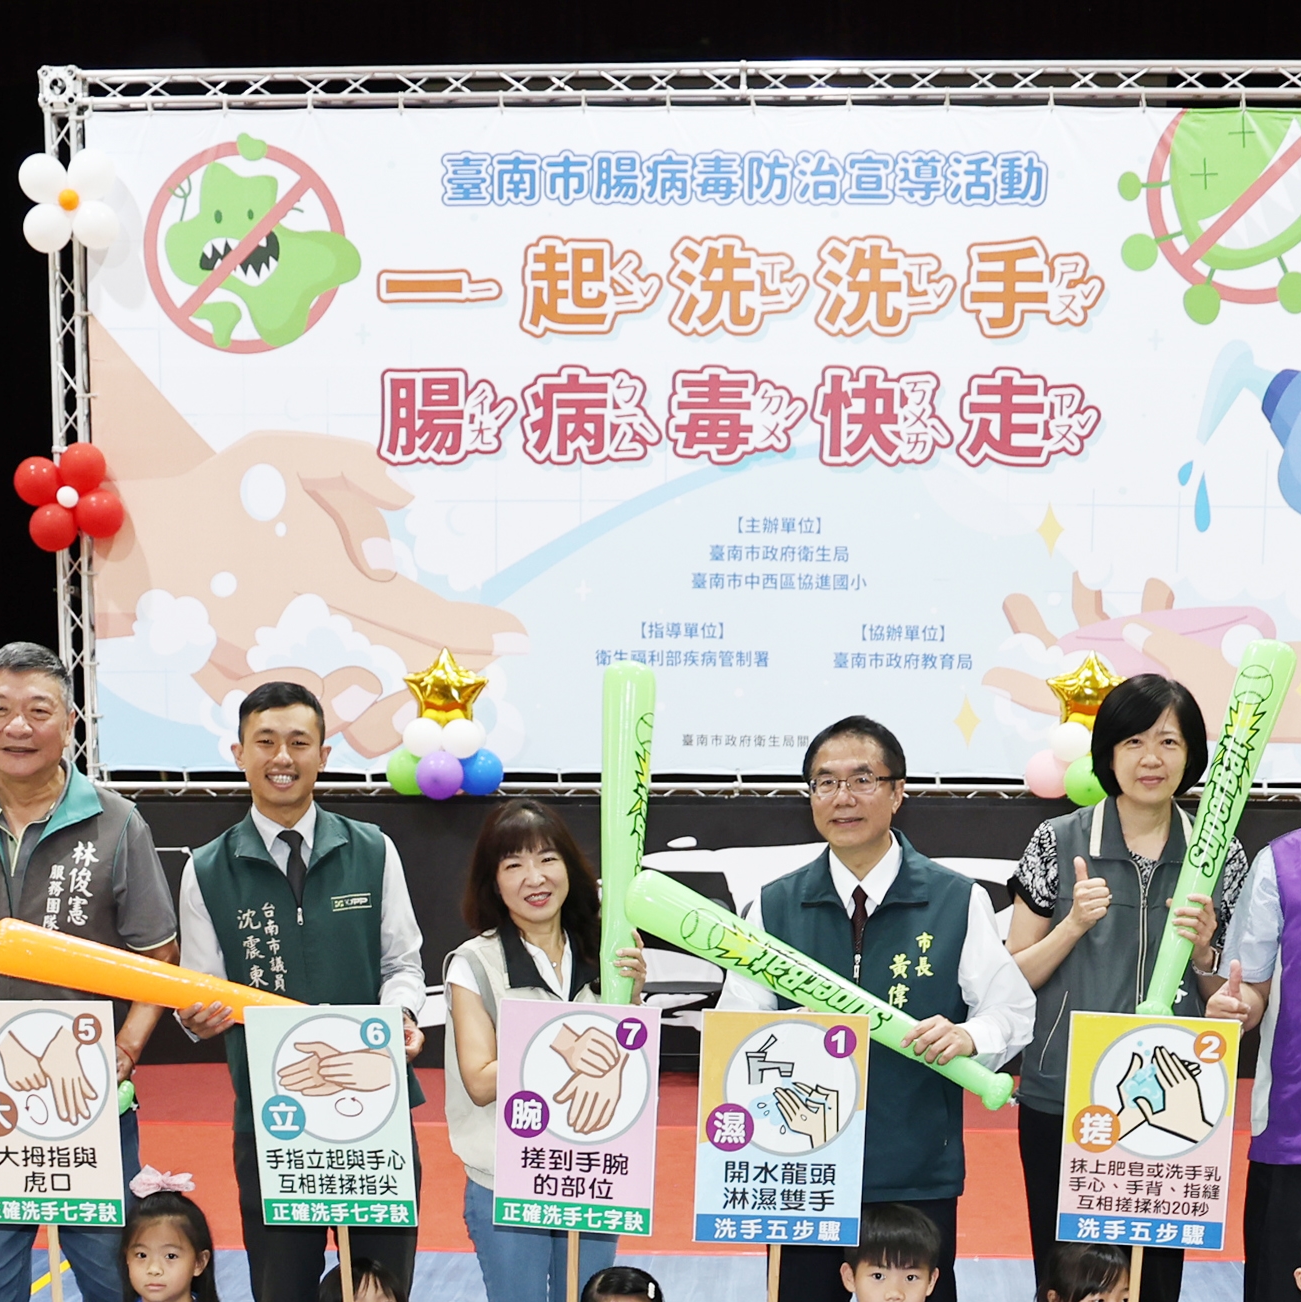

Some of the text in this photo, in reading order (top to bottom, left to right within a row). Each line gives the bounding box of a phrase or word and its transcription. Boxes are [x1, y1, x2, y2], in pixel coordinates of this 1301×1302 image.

[444, 152, 1047, 204] 臺南市腸病毒防治宣導活動
[736, 516, 823, 534] 【主辦單位】
[708, 544, 850, 563] 臺南市政府衛生局
[691, 572, 867, 592] 臺南市中西區協進國小
[638, 622, 726, 640] 【指導單位】
[859, 624, 947, 643] 【協辦單位】
[832, 651, 973, 670] 臺南市政府教育局
[67, 841, 100, 927] 林俊憲
[236, 908, 269, 989] 沈震東
[261, 902, 288, 993] 台南市議員
[914, 931, 935, 978] 市長
[78, 1018, 96, 1041] 5
[366, 1022, 386, 1046] 6
[622, 1022, 642, 1046] 7
[830, 1029, 847, 1054] 1
[1199, 1035, 1222, 1060] 2
[268, 1102, 300, 1132] 立
[510, 1098, 543, 1131] 腕
[1079, 1112, 1113, 1146] 搓
[265, 1148, 406, 1171] 手指立起與手心
[520, 1146, 629, 1176] 搓到手腕
[1069, 1158, 1222, 1182] 抹上肥皂或洗手乳
[23, 1171, 72, 1193] 虎口
[278, 1174, 399, 1196] 互相搓揉指尖
[724, 1160, 837, 1186] 開水龍頭
[533, 1173, 614, 1200] 的部位
[1068, 1176, 1221, 1200] 手心、手背、指縫
[271, 1202, 410, 1223] 正確洗手七字訣
[501, 1201, 644, 1232] 正確洗手七字訣
[1076, 1194, 1210, 1217] 互相搓揉約20秒
[713, 1217, 842, 1242] 洗手五步驟
[1076, 1217, 1207, 1246] 洗手五步驟
